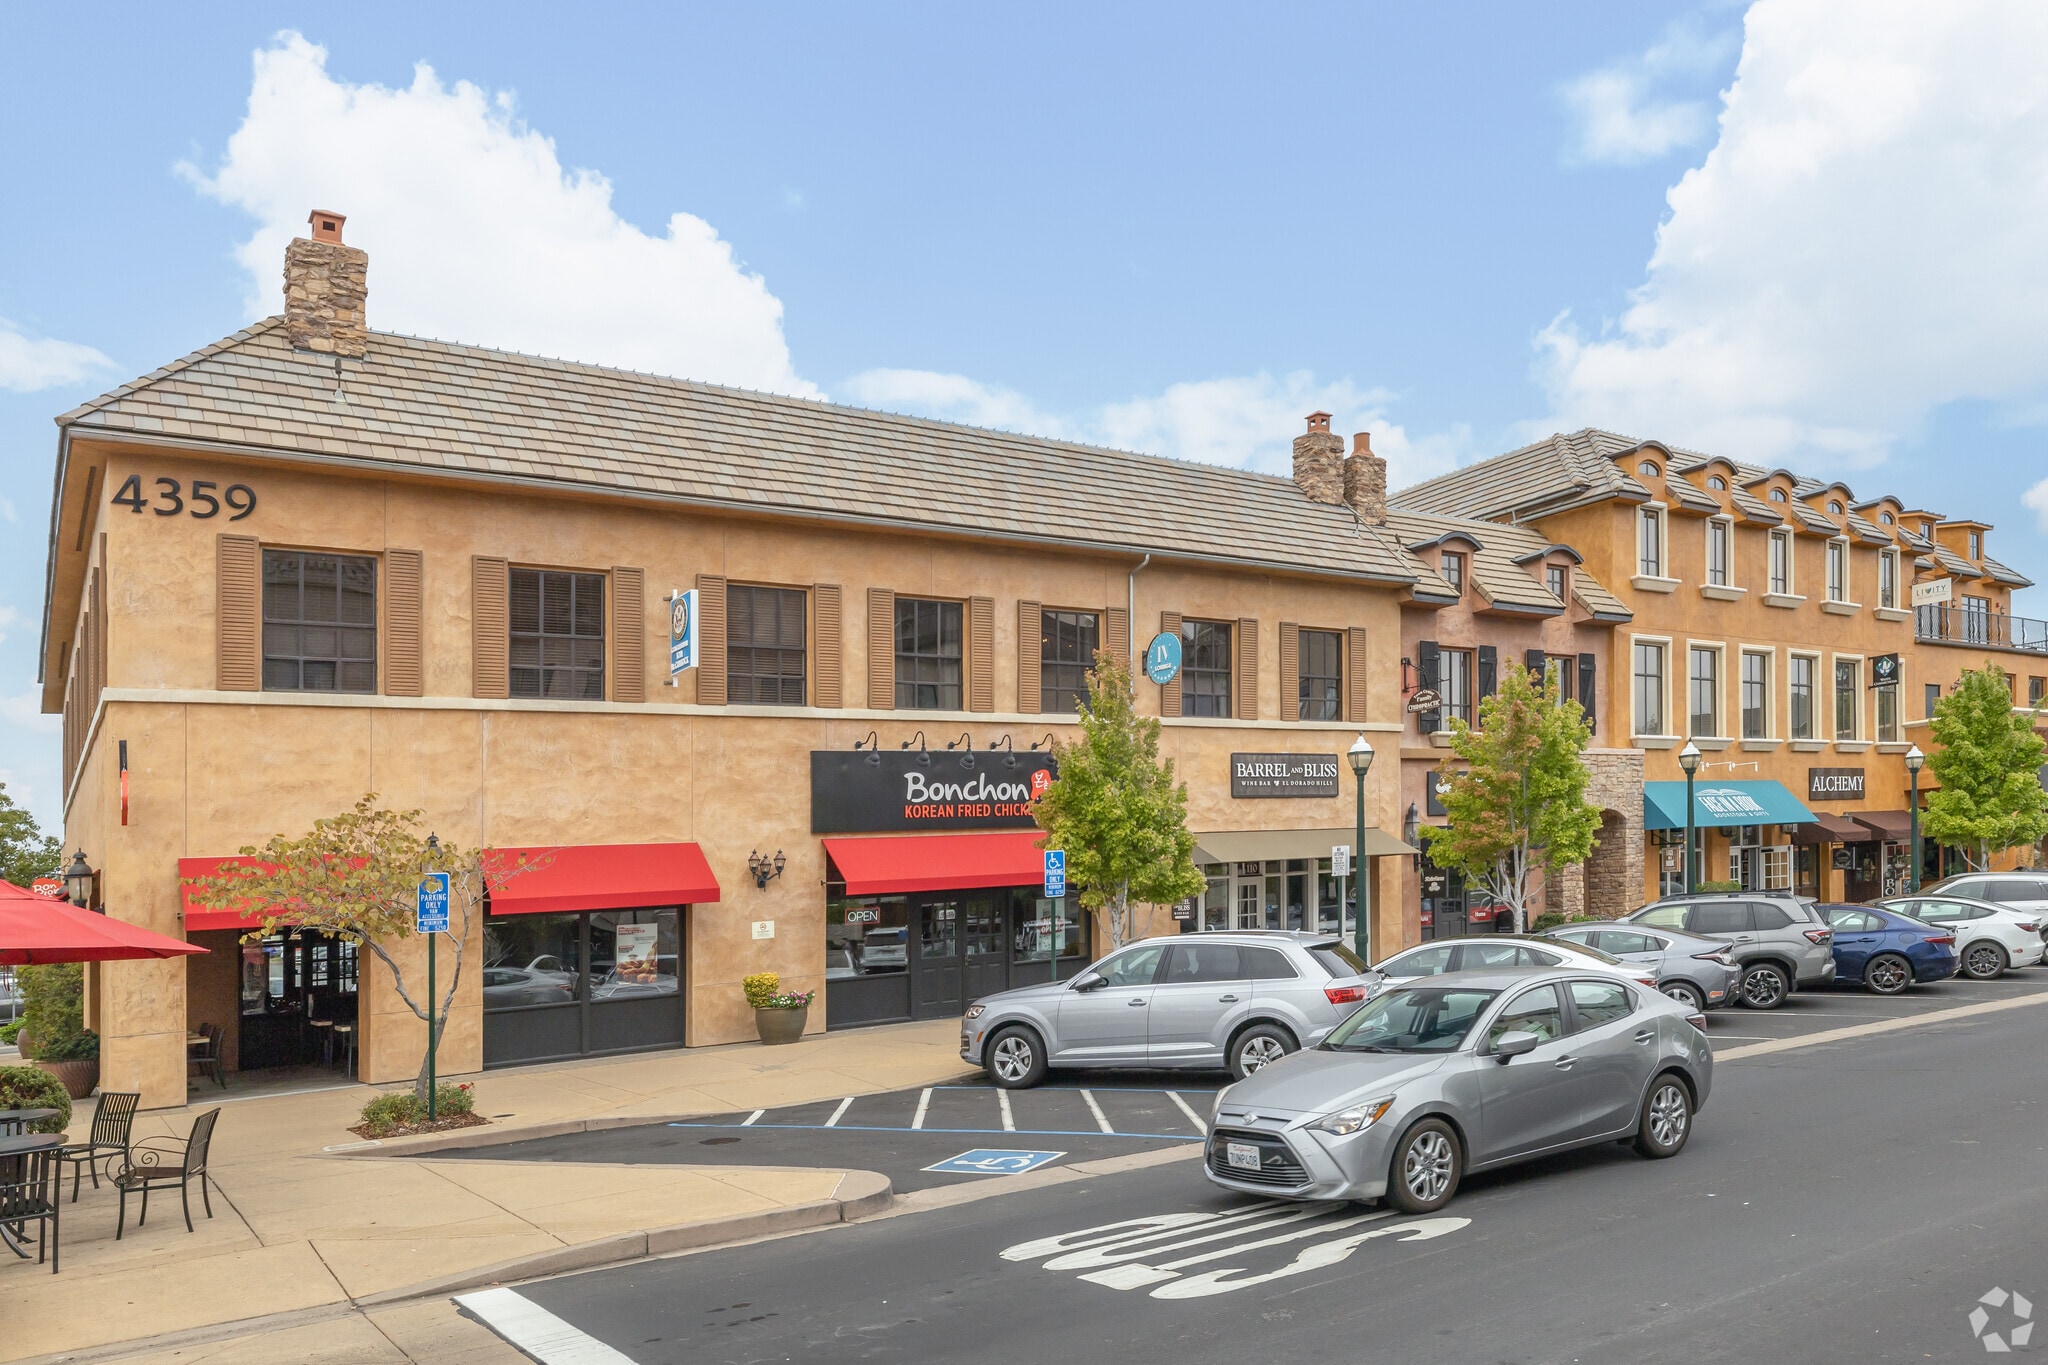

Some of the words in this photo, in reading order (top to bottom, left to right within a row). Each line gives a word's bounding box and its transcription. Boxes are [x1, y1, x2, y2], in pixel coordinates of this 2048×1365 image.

[111, 474, 257, 521] 4359
[1236, 763, 1291, 777] BARREL
[1303, 763, 1338, 777] BLISS
[904, 772, 1030, 803] Bonchon
[1812, 775, 1864, 791] ALCHEMY
[904, 804, 954, 819] KOREAN
[957, 803, 991, 818] FRIED
[994, 803, 1034, 817] CHICK
[1246, 863, 1258, 873] 110
[420, 893, 447, 902] PARKING
[425, 901, 442, 909] ONLY
[847, 910, 878, 922] OPEN
